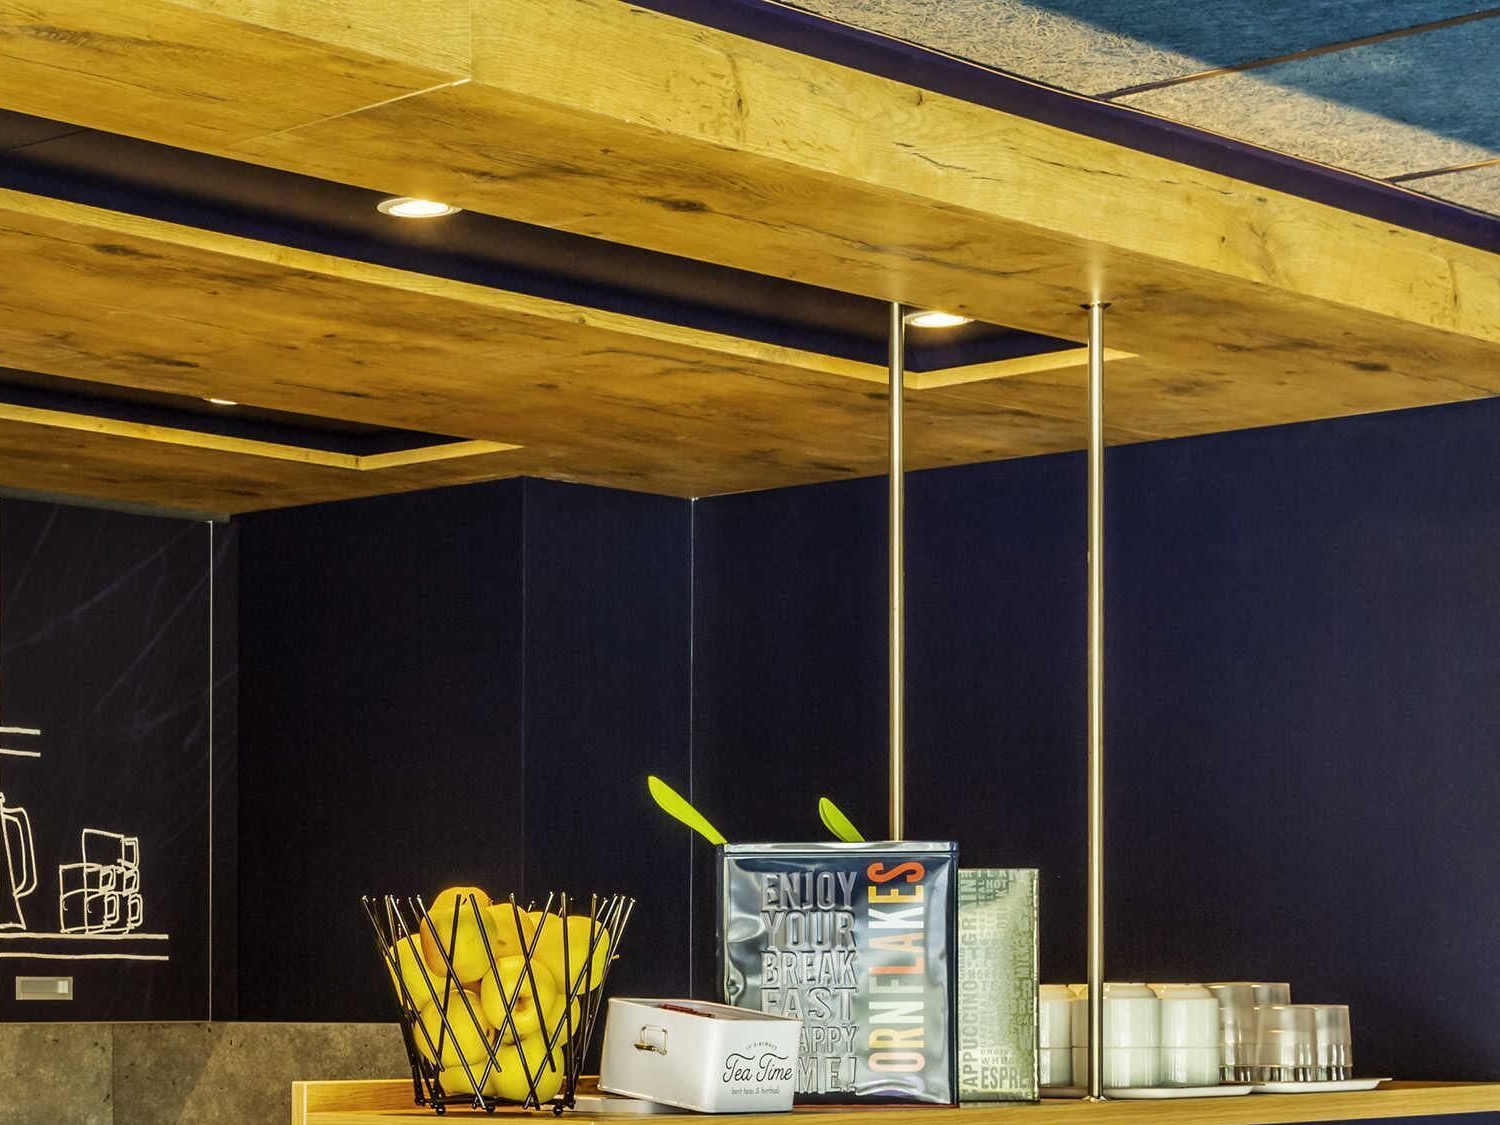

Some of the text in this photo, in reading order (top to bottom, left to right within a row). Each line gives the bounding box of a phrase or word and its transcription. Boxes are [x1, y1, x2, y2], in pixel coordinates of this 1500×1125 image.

[761, 871, 858, 910] ENJOY
[760, 910, 858, 949] YOUR
[761, 951, 859, 985] BREAK
[760, 987, 858, 1021] FAST
[798, 1025, 859, 1054] APPY
[722, 1052, 794, 1083] Tea Time
